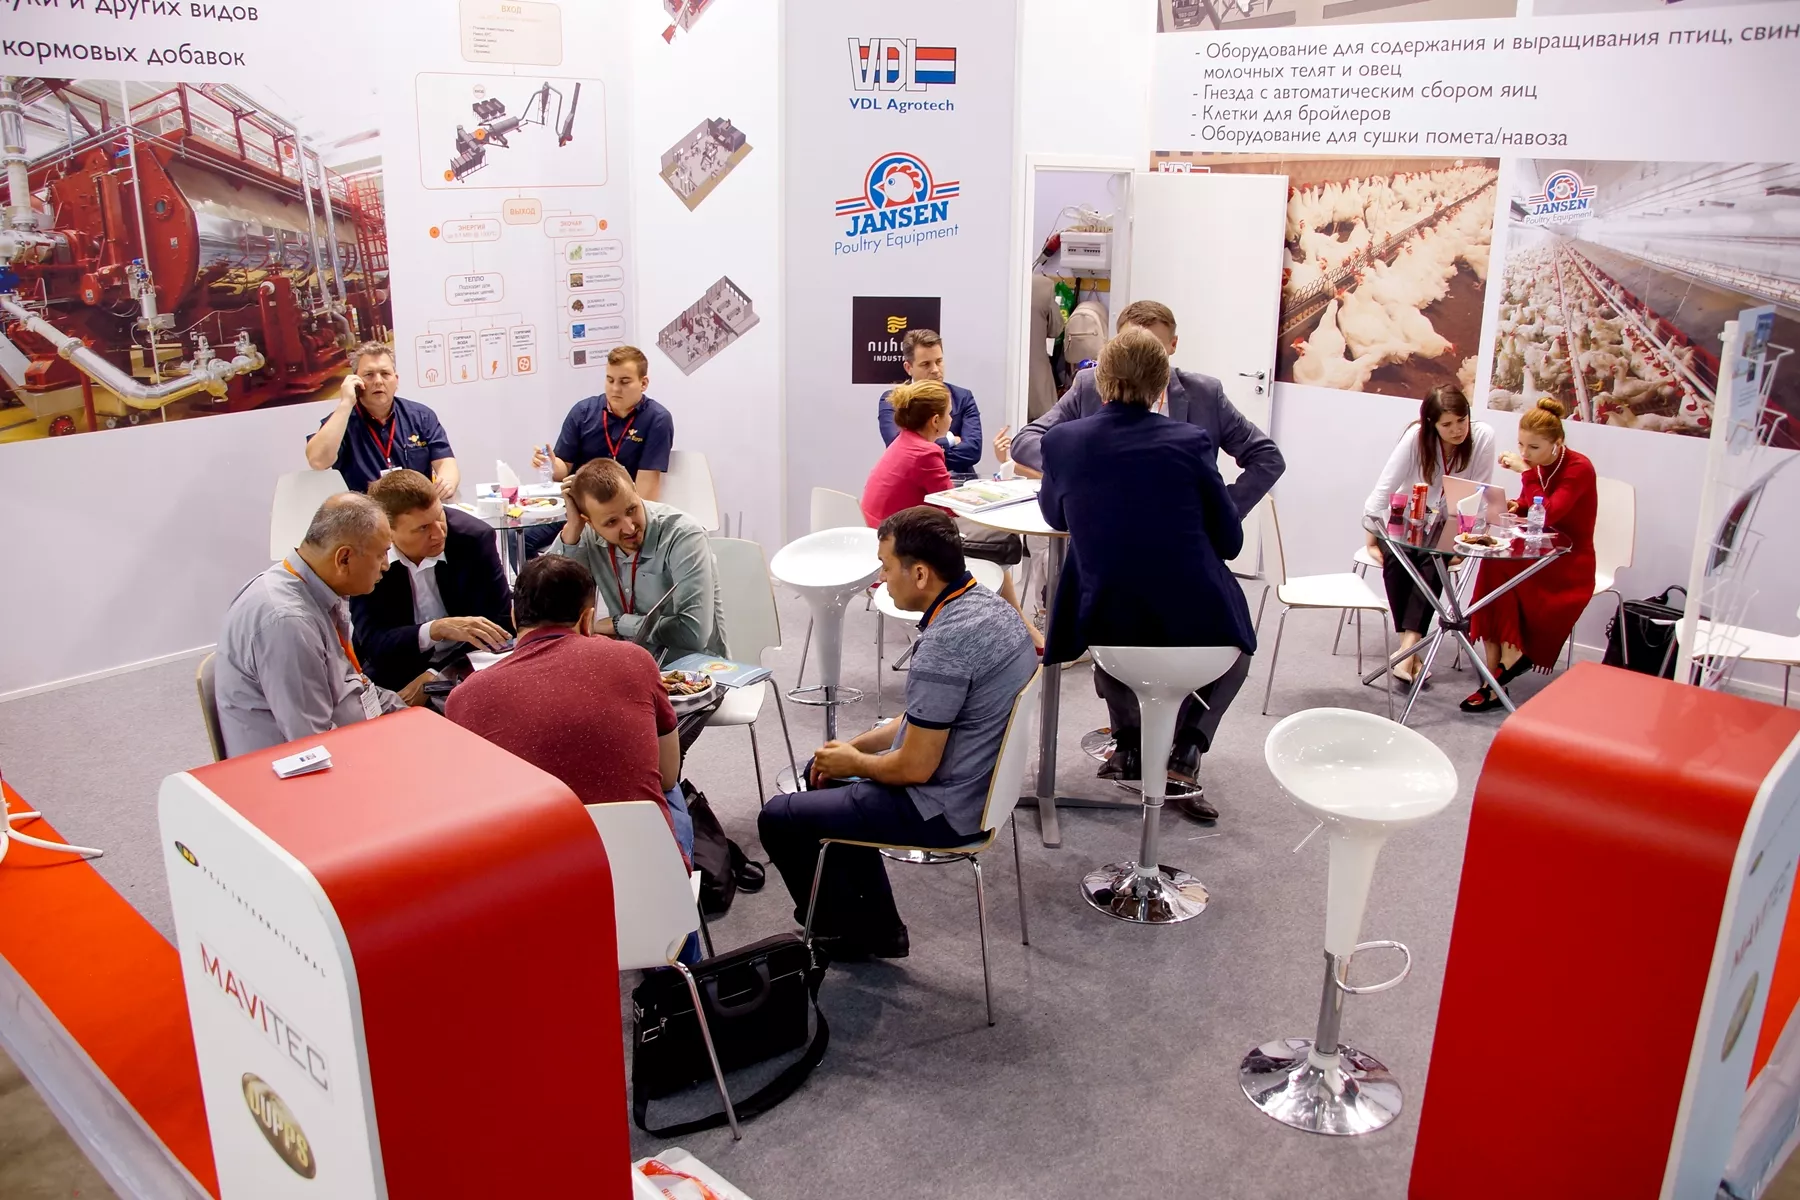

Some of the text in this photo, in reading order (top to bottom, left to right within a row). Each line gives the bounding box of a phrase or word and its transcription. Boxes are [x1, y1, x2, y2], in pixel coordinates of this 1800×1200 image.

[95, 0, 181, 20] других
[190, 2, 259, 21] видов
[501, 5, 522, 14] ВХОД
[2, 40, 246, 66] кормовых добавок
[1206, 42, 1327, 62] Оборудование
[1333, 42, 1364, 56] для
[1371, 38, 1485, 58] содержания
[1493, 39, 1505, 50] и
[1513, 31, 1659, 54] выращивания
[1668, 27, 1733, 45] птиц,
[848, 38, 927, 91] VDL
[1203, 64, 1402, 79] молочных телят и овец
[1203, 80, 1538, 103] Гнезда с автоматическим сбором яиц
[849, 98, 954, 113] VDL Agrotech
[1203, 104, 1391, 127] Клетки для бройлеров
[1201, 126, 1568, 147] Оборудование для сушки помета/навоза
[510, 208, 535, 216] ВЫХОД
[1533, 198, 1588, 215] JANSEN
[845, 200, 949, 237] JANSEN
[1525, 211, 1592, 225] Poultry Equipment
[834, 224, 959, 255] Poultry Equipment
[201, 942, 329, 1091] MAVITEC
